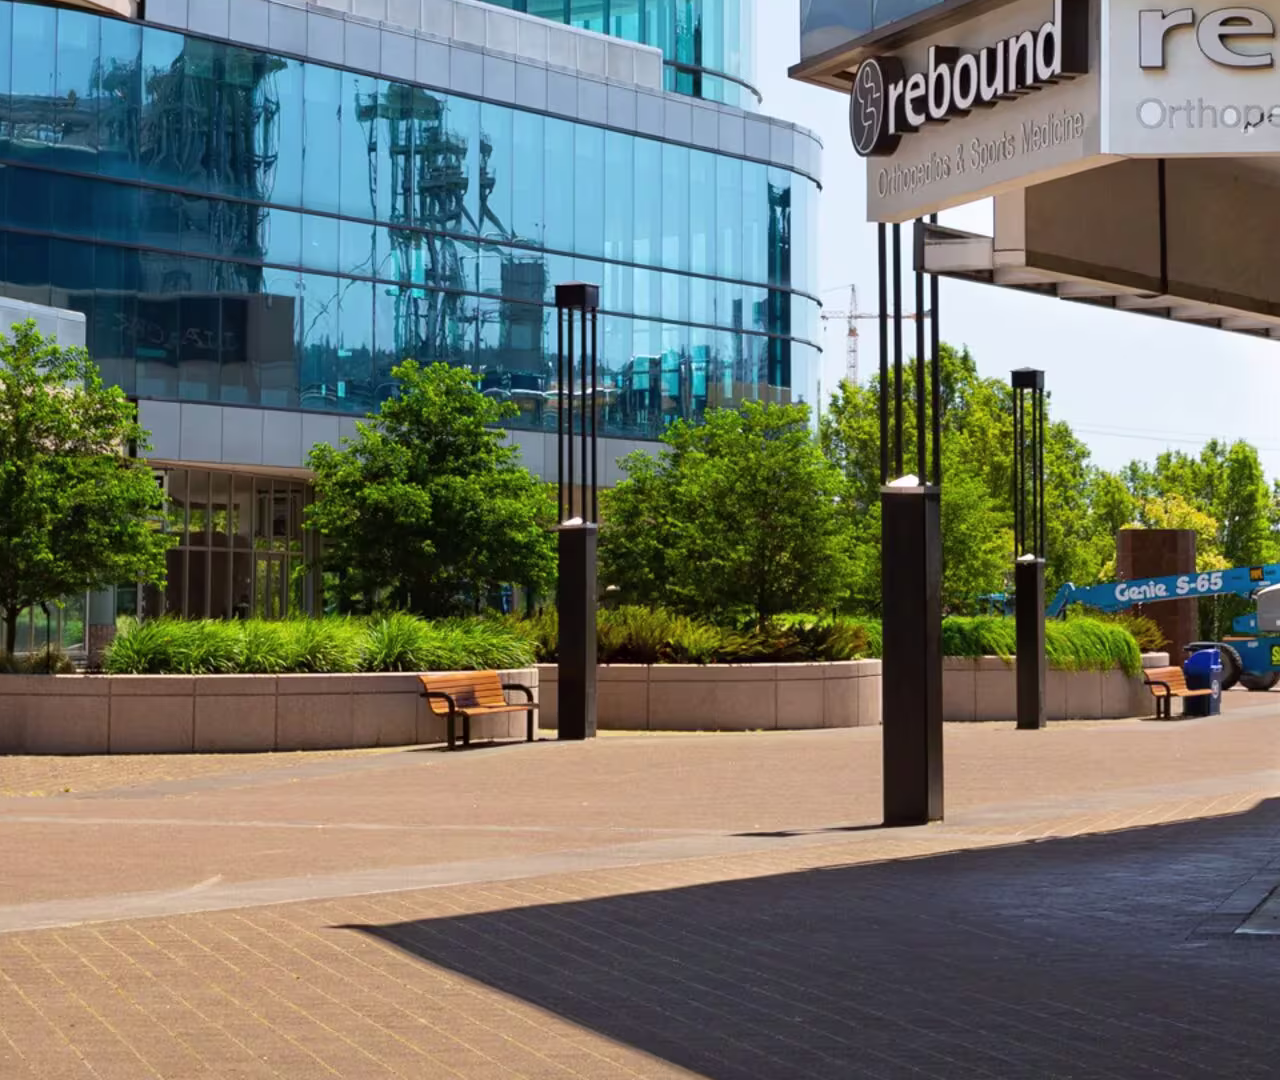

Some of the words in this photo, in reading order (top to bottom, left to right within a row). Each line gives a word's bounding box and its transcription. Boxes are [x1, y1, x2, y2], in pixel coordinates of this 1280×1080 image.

[878, 154, 951, 198] Orthopedics
[955, 144, 965, 175] &
[970, 132, 1015, 172] Sports
[1021, 110, 1084, 154] Medicine
[1114, 581, 1168, 601] Genie
[1176, 572, 1223, 595] S-65
